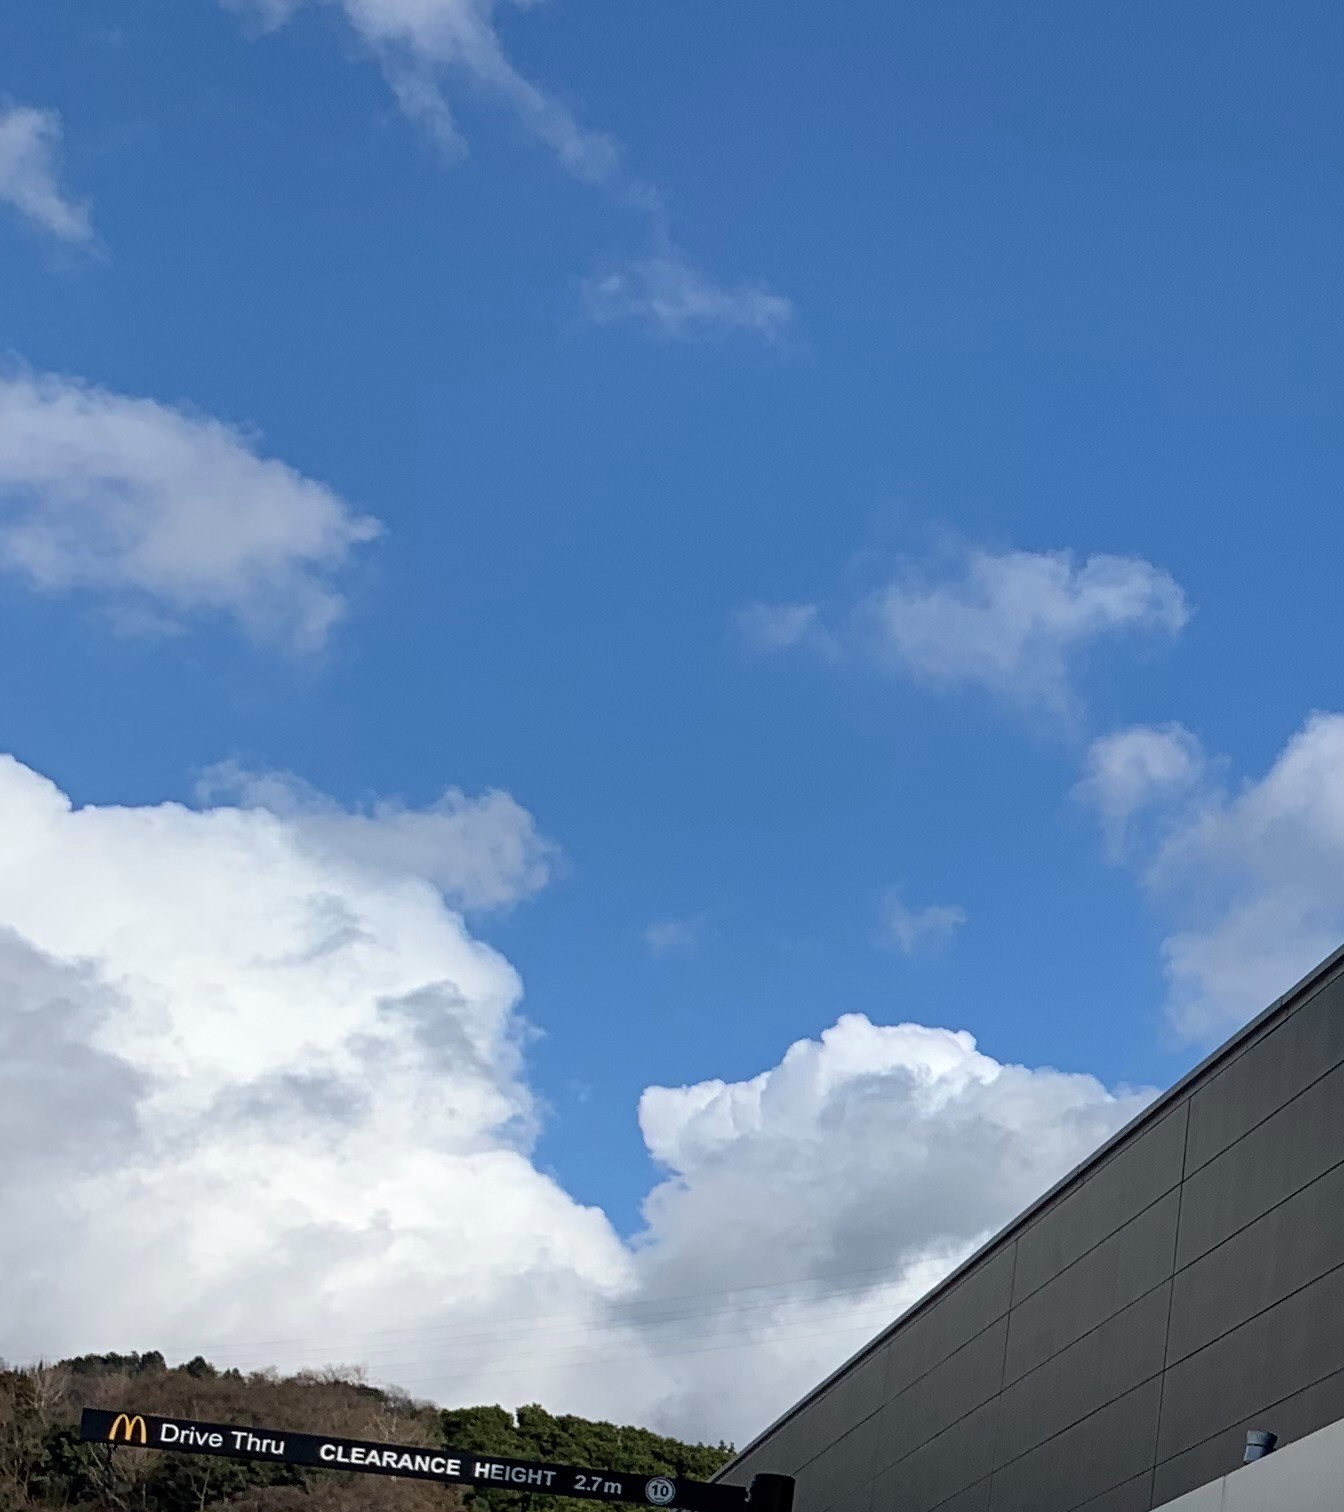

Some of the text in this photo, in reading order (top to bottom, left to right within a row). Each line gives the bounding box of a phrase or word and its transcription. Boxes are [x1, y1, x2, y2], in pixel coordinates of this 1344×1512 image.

[160, 1423, 223, 1447] Drive
[231, 1430, 285, 1455] Thru
[319, 1444, 461, 1478] CLEARANCE
[474, 1462, 556, 1486] HEIGHT
[652, 1485, 669, 1497] 10
